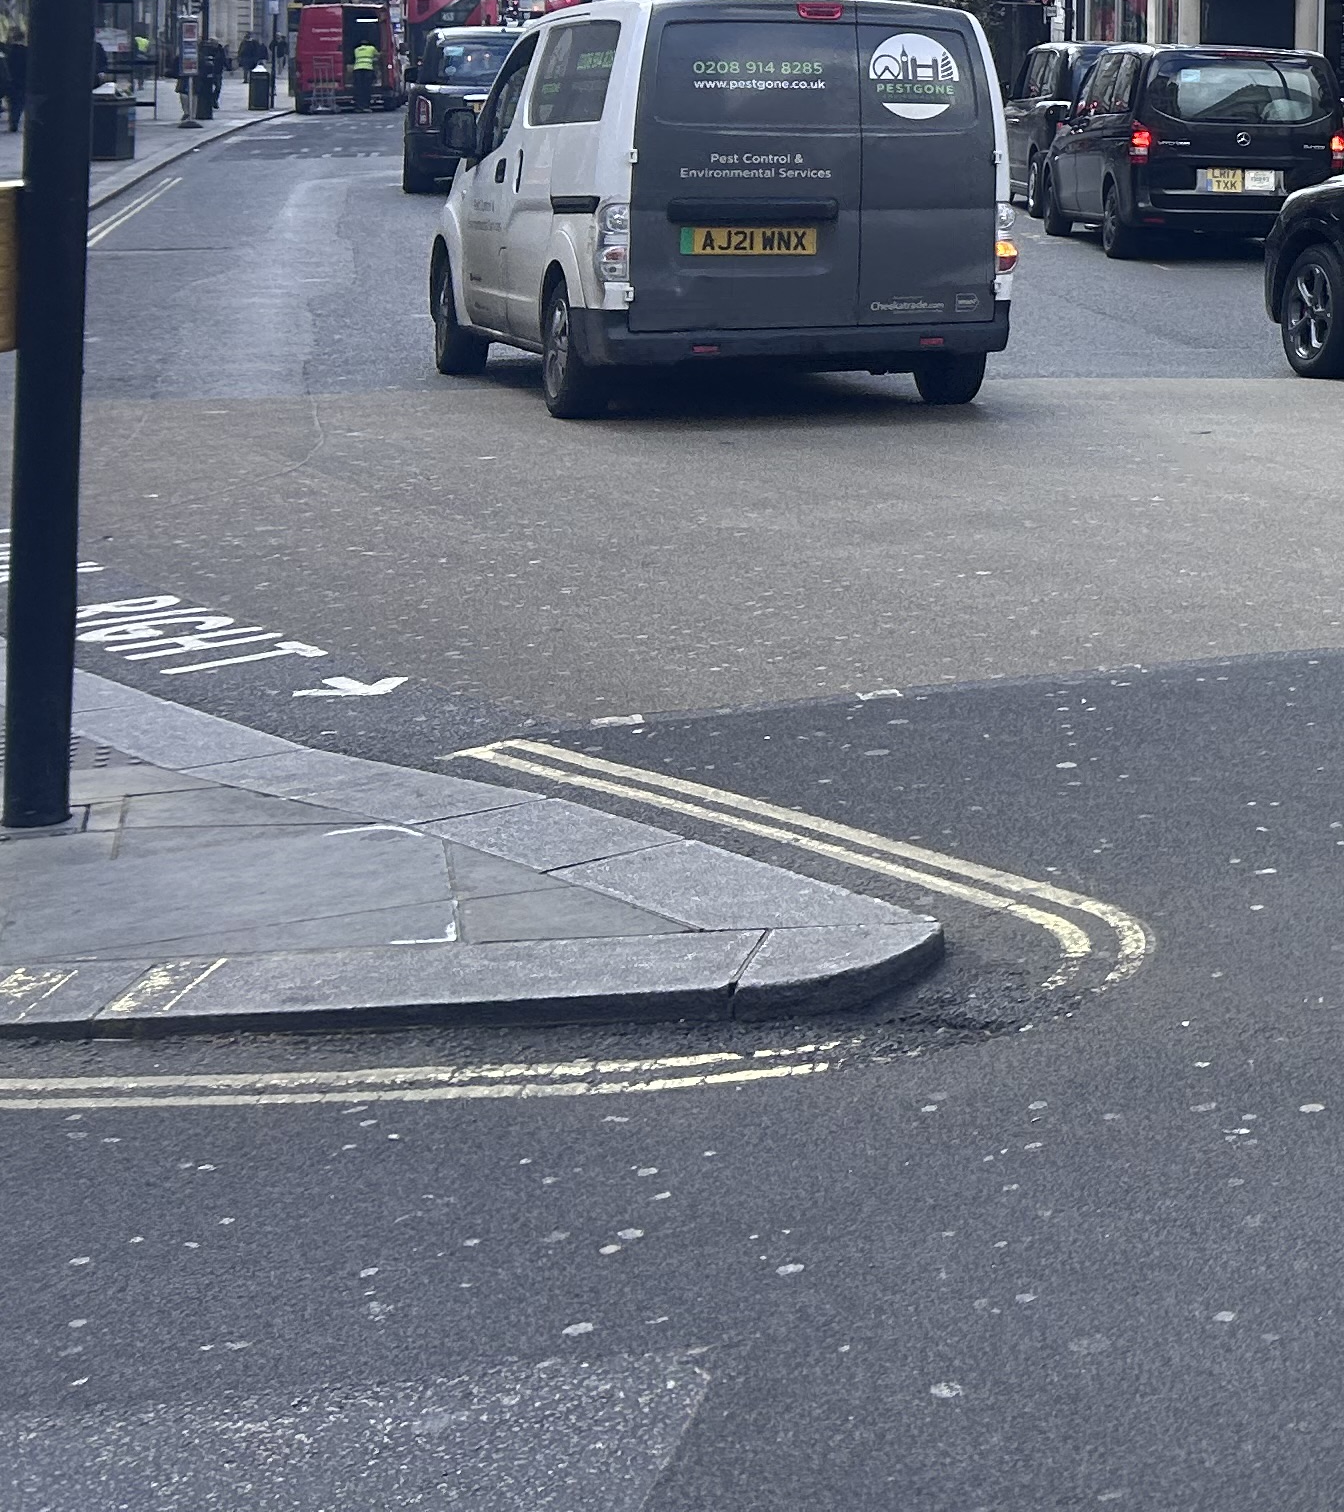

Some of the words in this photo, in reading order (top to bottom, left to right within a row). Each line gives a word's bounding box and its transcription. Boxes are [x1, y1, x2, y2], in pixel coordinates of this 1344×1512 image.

[693, 61, 740, 74] 0208
[745, 61, 775, 74] 914
[781, 62, 823, 75] 8285
[693, 79, 826, 90] www.pestgone.co.uk
[876, 83, 955, 95] PESTGONE
[710, 153, 739, 164] Pest
[742, 153, 791, 164] Control
[794, 154, 804, 164] &
[680, 167, 775, 178] Environmental
[778, 168, 832, 179] Services
[1215, 180, 1238, 190] TXK
[701, 230, 754, 251] AJ21
[762, 230, 807, 251] WNX
[76, 594, 329, 675] RIGHT
